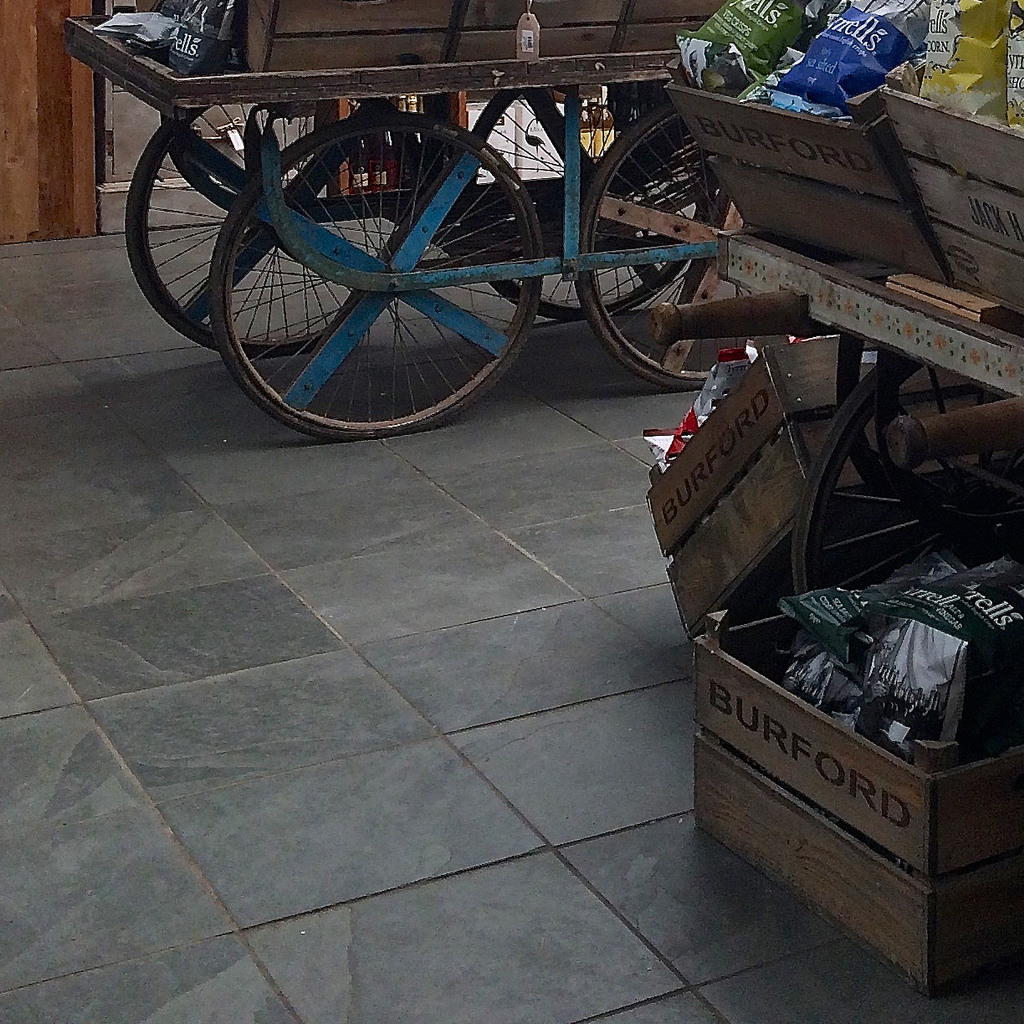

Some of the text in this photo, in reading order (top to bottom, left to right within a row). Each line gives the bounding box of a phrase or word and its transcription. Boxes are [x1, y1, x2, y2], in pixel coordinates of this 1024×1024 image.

[695, 114, 875, 173] BURFORD
[967, 195, 1010, 237] JACK
[660, 388, 770, 526] BURFORD
[708, 677, 911, 829] BURFORD
